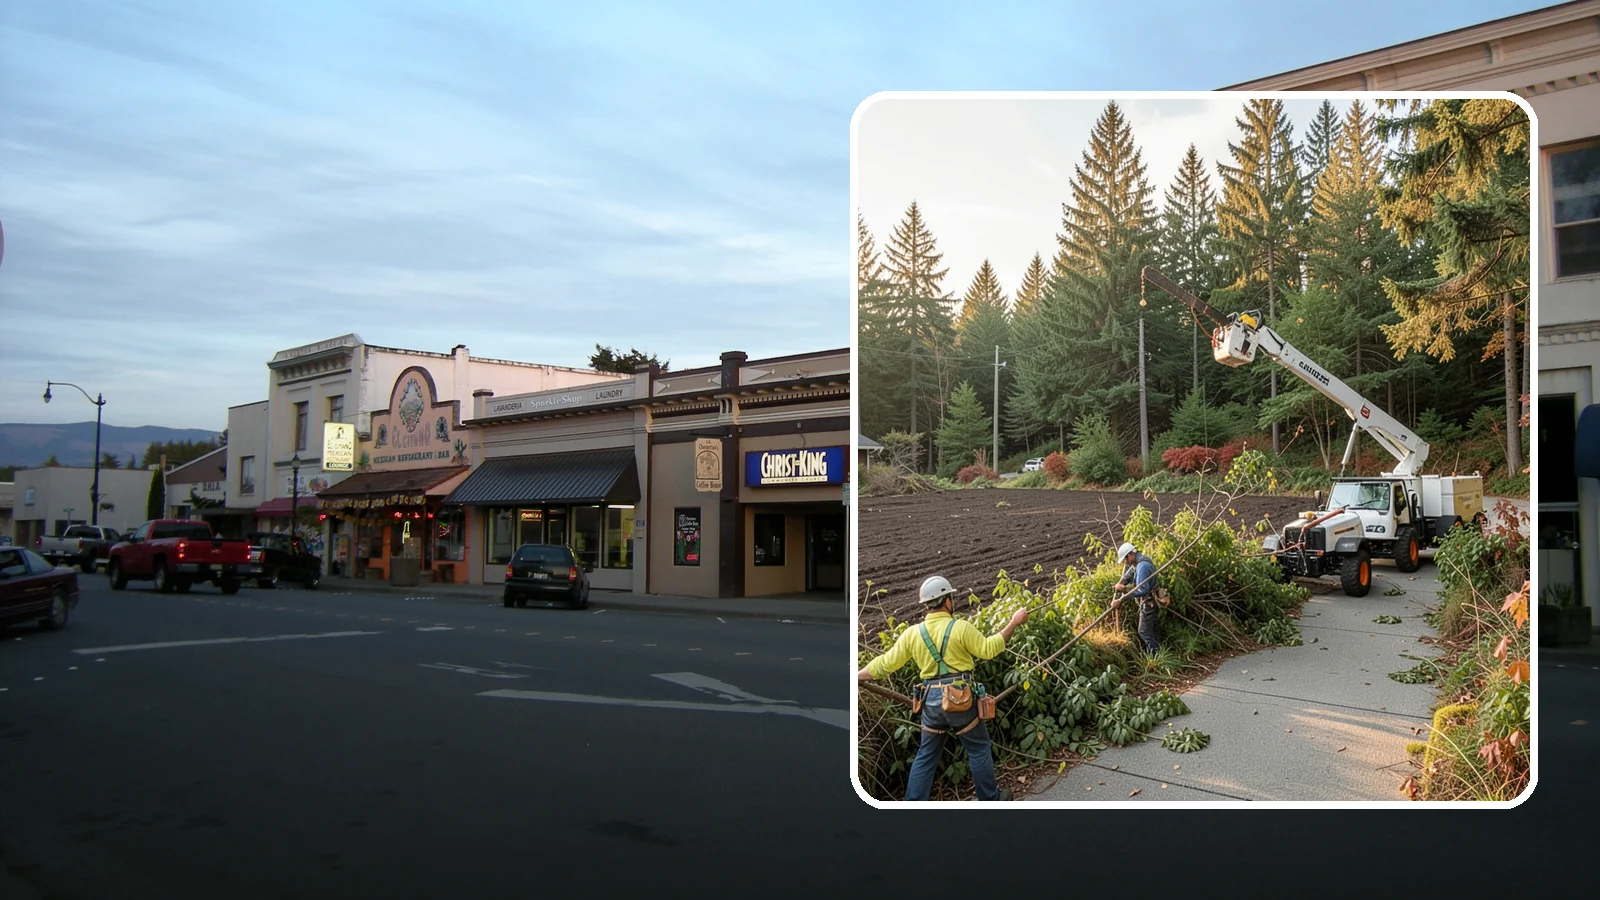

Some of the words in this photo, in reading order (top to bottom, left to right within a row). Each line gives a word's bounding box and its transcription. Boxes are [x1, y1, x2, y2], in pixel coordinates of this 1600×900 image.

[493, 402, 522, 412] LAVANDERIA
[530, 397, 561, 409] Sparkle
[561, 394, 582, 404] Shop
[595, 389, 623, 400] LAUNDRY
[373, 454, 396, 464] MEXICAN
[397, 451, 433, 462] RESTAURANT
[437, 450, 450, 459] BAR
[761, 452, 797, 478] CHRIST
[799, 450, 827, 476] KING
[696, 480, 710, 488] Coffee
